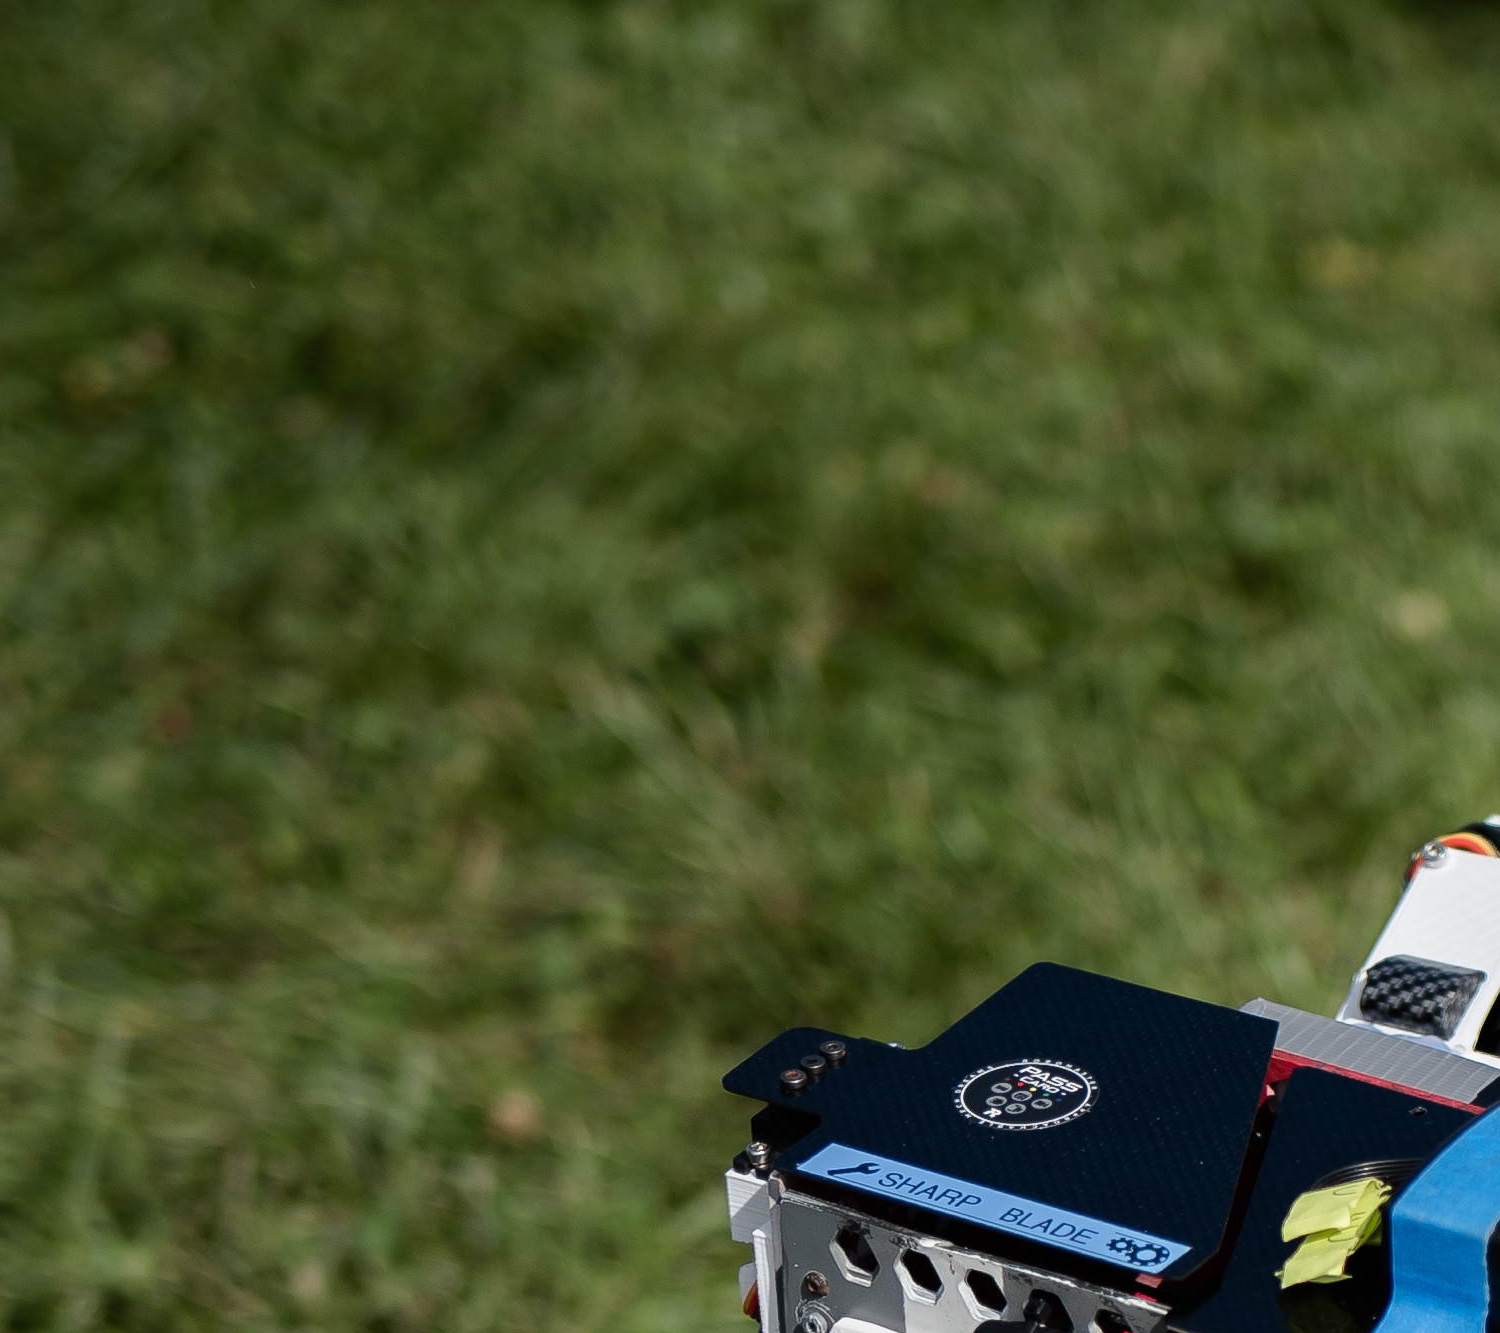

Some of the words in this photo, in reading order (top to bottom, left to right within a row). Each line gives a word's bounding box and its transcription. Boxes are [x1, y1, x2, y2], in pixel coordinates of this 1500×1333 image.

[1018, 1065, 1084, 1093] PASS
[1019, 1075, 1060, 1095] CARD
[878, 1172, 982, 1208] SHARP
[999, 1207, 1100, 1245] BLADE
